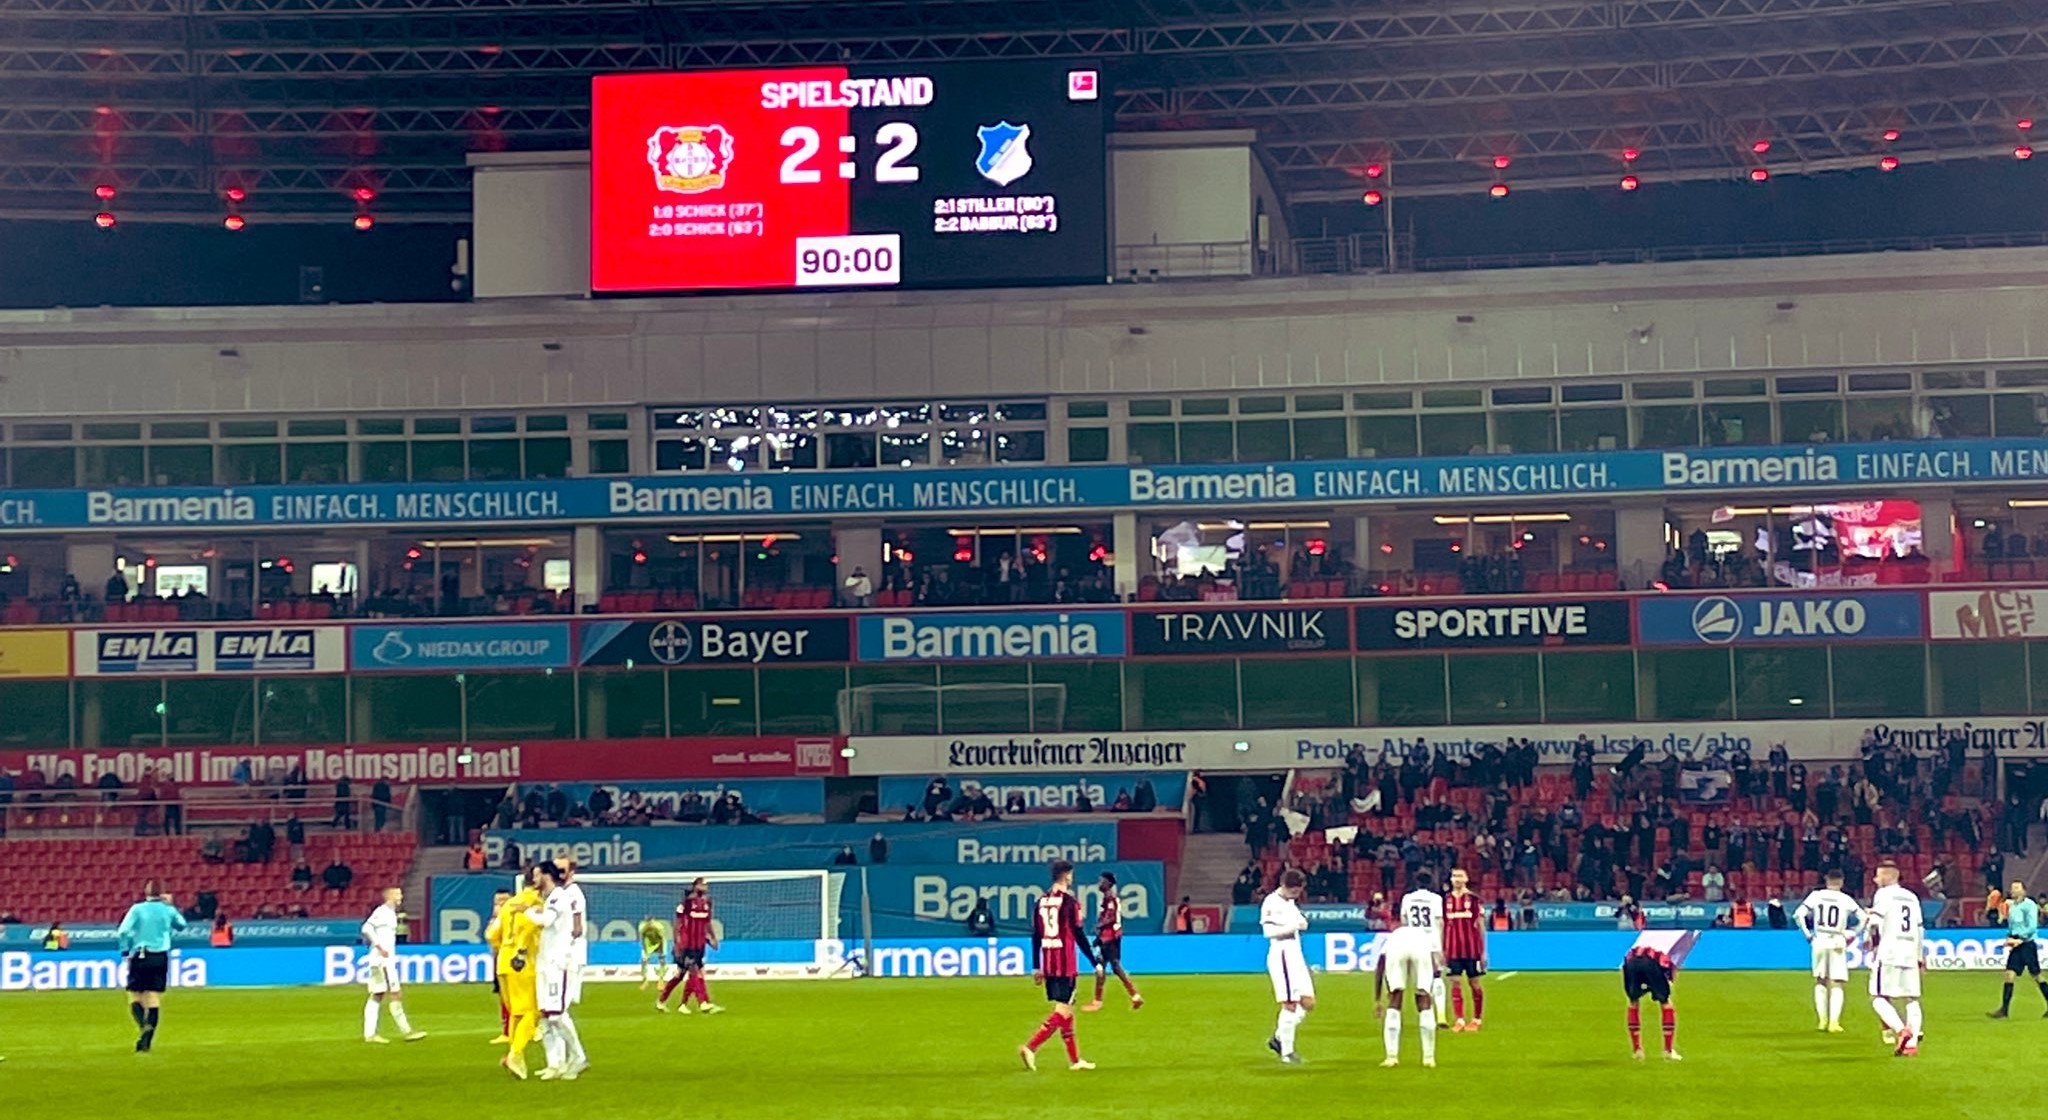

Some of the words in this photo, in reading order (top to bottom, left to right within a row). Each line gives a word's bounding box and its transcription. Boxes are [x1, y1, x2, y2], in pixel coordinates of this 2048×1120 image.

[761, 77, 934, 109] SPIELSTAND
[779, 126, 821, 184] 2
[875, 121, 920, 182] 2
[675, 204, 726, 218] SCHICK
[957, 197, 1015, 214] STILLER
[674, 222, 725, 236] SCHICK
[802, 247, 893, 274] 90:00
[1130, 466, 1296, 501] Barmenia
[1314, 469, 1429, 497] EINFACH.
[1439, 462, 1617, 493] MENSCHLICH.
[1663, 448, 1838, 486] Barmenia
[1857, 451, 1980, 479] EINFACH.
[87, 489, 255, 523] Barmenia
[272, 494, 386, 519] EINFACH.
[396, 491, 565, 518] MENSCHLICH.
[609, 479, 772, 512] Barmenia
[790, 484, 902, 509] EINFACH.
[913, 478, 1084, 507] MENSCHLICH.
[1156, 610, 1325, 642] TRAVNIK
[1394, 606, 1588, 639] SPORTFIVE
[1753, 600, 1865, 636] JAKO
[102, 630, 197, 661] EMKA
[218, 628, 313, 660] EMKA
[418, 641, 484, 658] NIEDAX
[486, 639, 550, 656] GROUP
[702, 624, 809, 663] Bayer
[883, 615, 1098, 658] Barmenia
[305, 748, 456, 781] Heimspiel
[463, 746, 520, 778] hat!
[1094, 737, 1188, 767] Anzeiger
[958, 838, 1106, 863] Barmenia
[1410, 905, 1431, 928] 33
[1818, 904, 1839, 928] 10
[1901, 905, 1911, 932] 3
